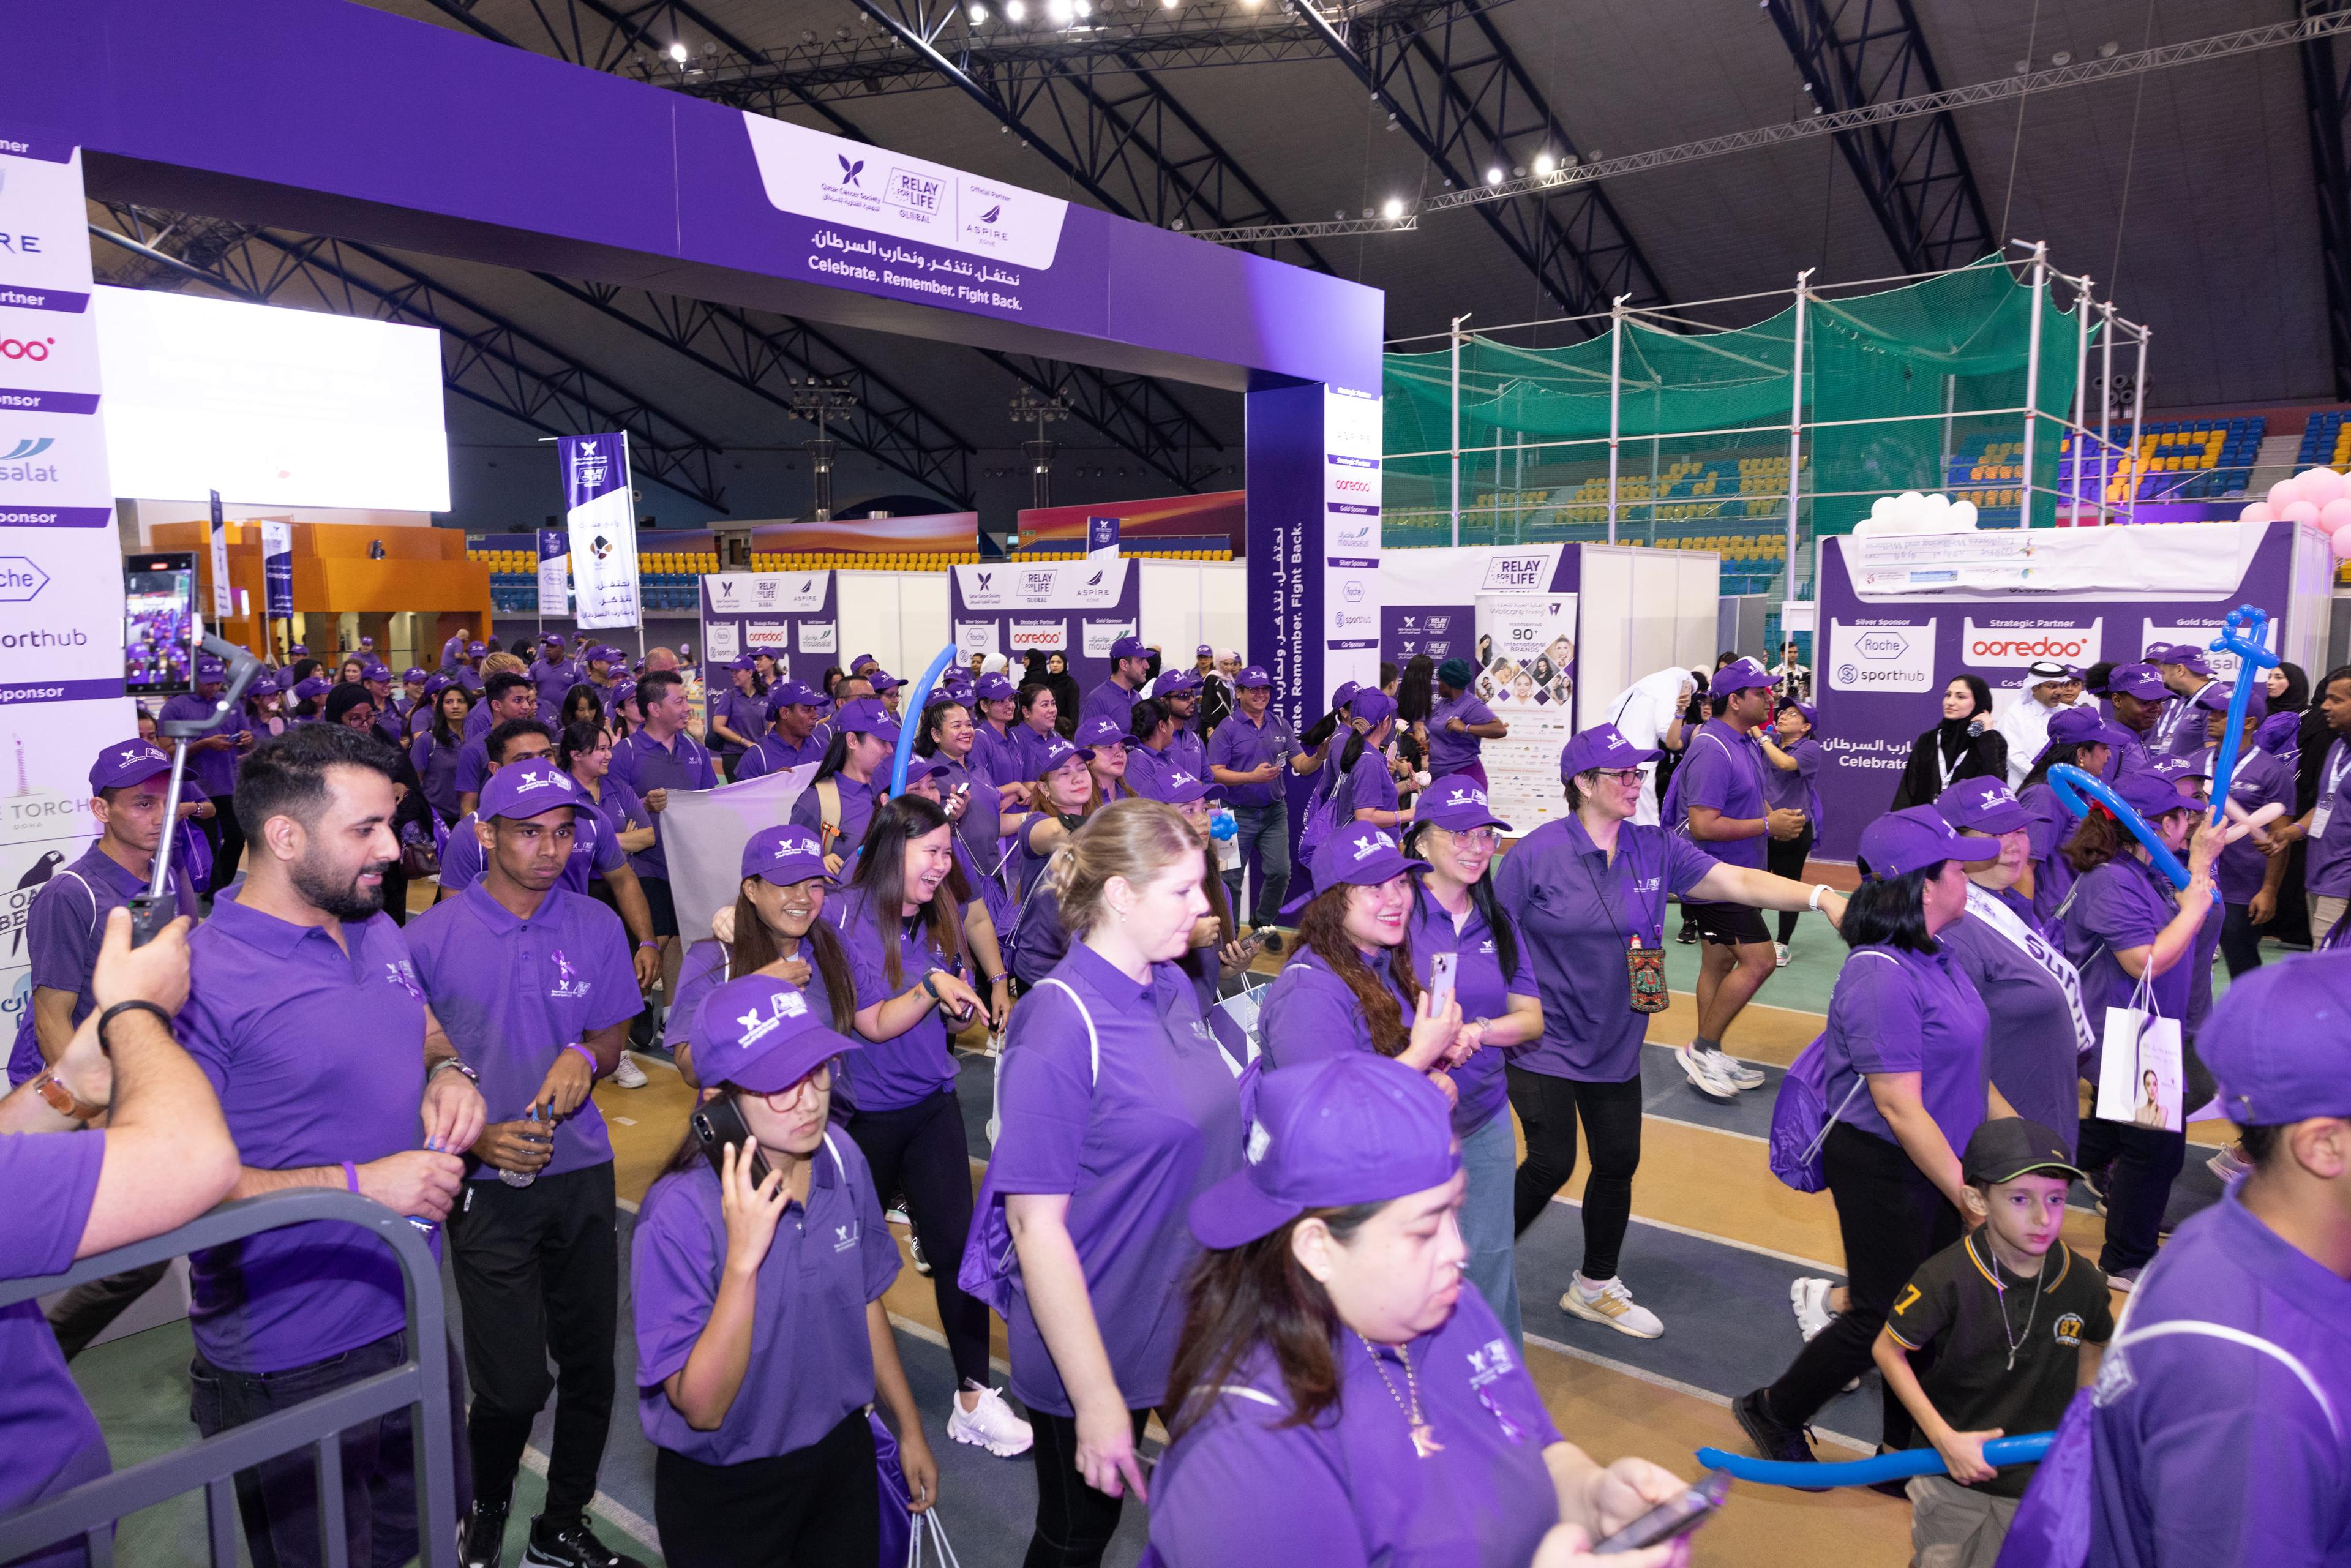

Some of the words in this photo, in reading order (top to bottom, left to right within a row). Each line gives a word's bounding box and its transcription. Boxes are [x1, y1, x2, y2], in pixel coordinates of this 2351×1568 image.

[902, 175, 938, 196] RELAY
[897, 188, 910, 197] FOR
[911, 193, 934, 209] LIFE
[899, 209, 931, 224] GLOBAL
[966, 224, 1008, 241] ASPIRE
[808, 255, 880, 282] Celebrate.
[883, 269, 956, 298] Remember.
[958, 285, 989, 304] Fight
[991, 292, 1024, 311] Back.
[1291, 522, 1302, 563] Back.
[1502, 560, 1541, 572] RELAY
[1029, 574, 1052, 583] RELAY
[1511, 573, 1535, 584] LIFE
[759, 582, 776, 591] RELAY
[1034, 583, 1049, 592] LIFE
[1291, 568, 1304, 607] Fight
[1990, 620, 2034, 628] Strategic
[749, 631, 782, 641] ooredoo
[970, 632, 985, 641] Roche
[1014, 630, 1059, 643] ooredoo
[1865, 639, 1900, 650] Roche
[1973, 636, 2081, 657] ooredoo
[1291, 612, 1302, 696] Remember.
[1861, 670, 1925, 682] sporthub
[11, 797, 91, 819] TORCH
[2059, 1320, 2081, 1338] 87
